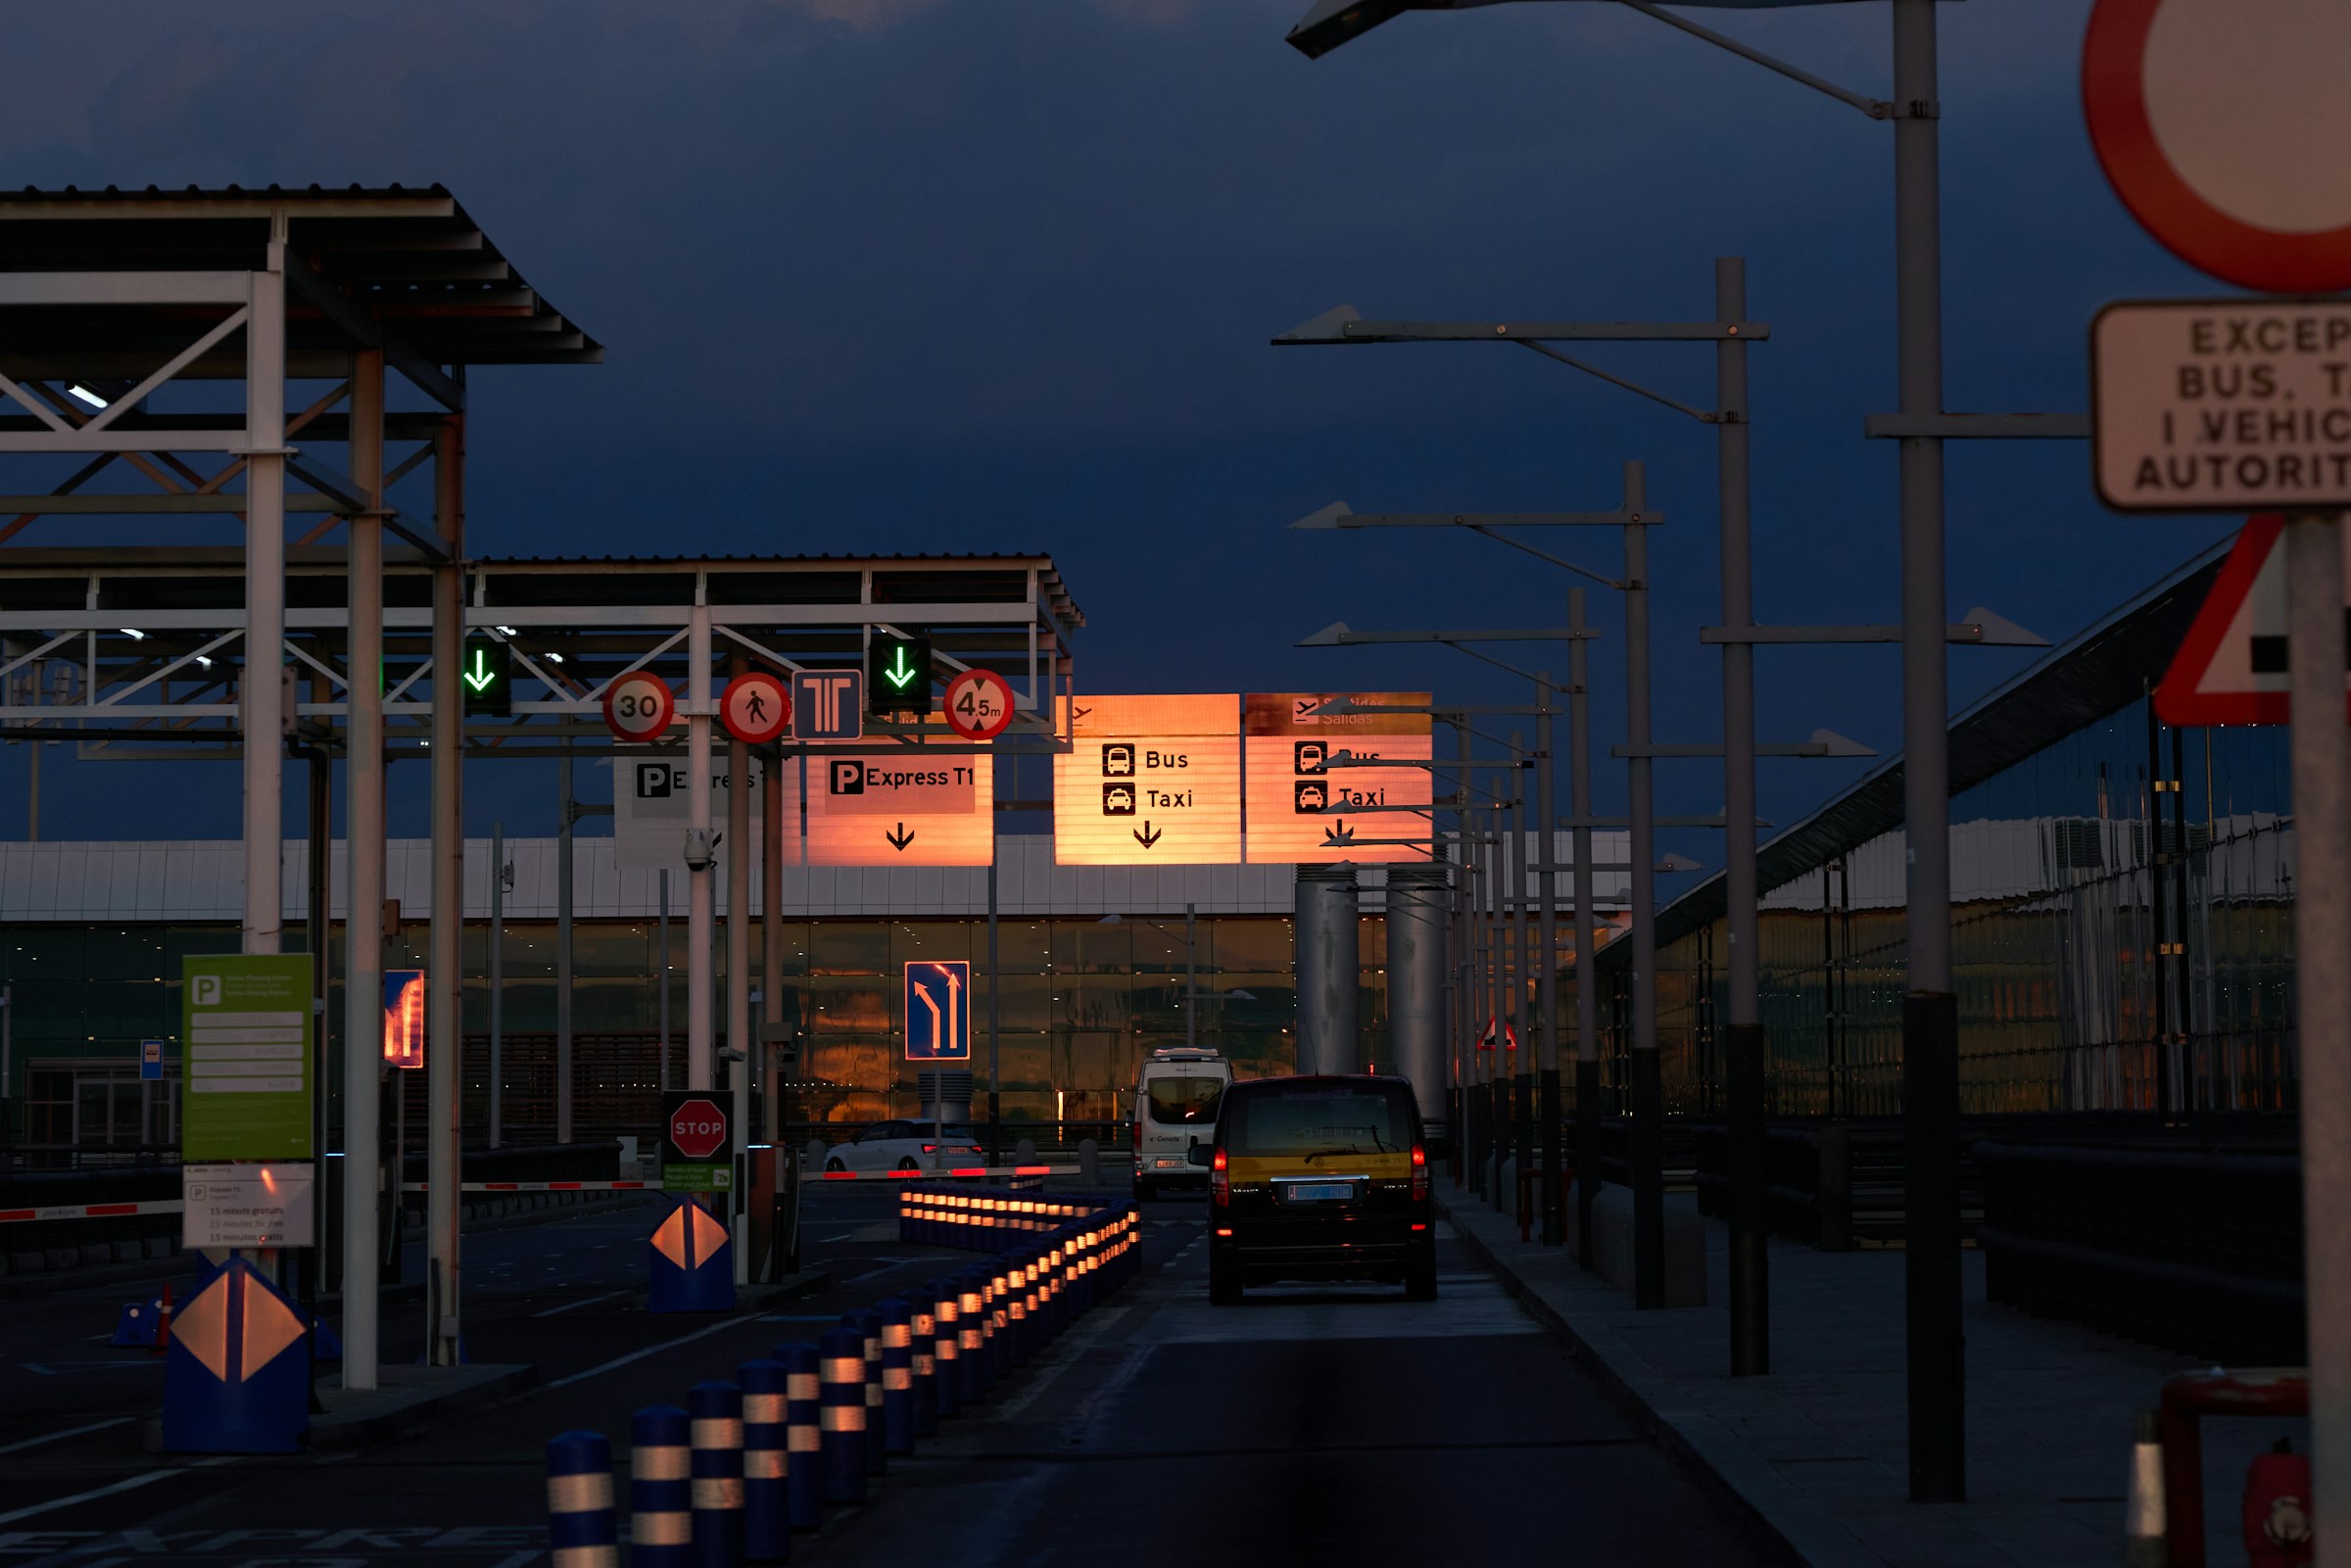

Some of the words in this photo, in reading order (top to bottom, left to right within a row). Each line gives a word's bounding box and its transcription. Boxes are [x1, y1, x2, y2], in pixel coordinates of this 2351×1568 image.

[2323, 363, 2351, 396] T
[2164, 410, 2173, 445] I
[619, 695, 657, 717] 30
[1146, 751, 1188, 768] Bus
[866, 769, 948, 790] Express
[953, 767, 974, 785] T1
[1147, 789, 1192, 808] Taxi
[1339, 787, 1384, 806] Taxi
[675, 1121, 722, 1135] STOP
[0, 1524, 551, 1557] EXPRE
